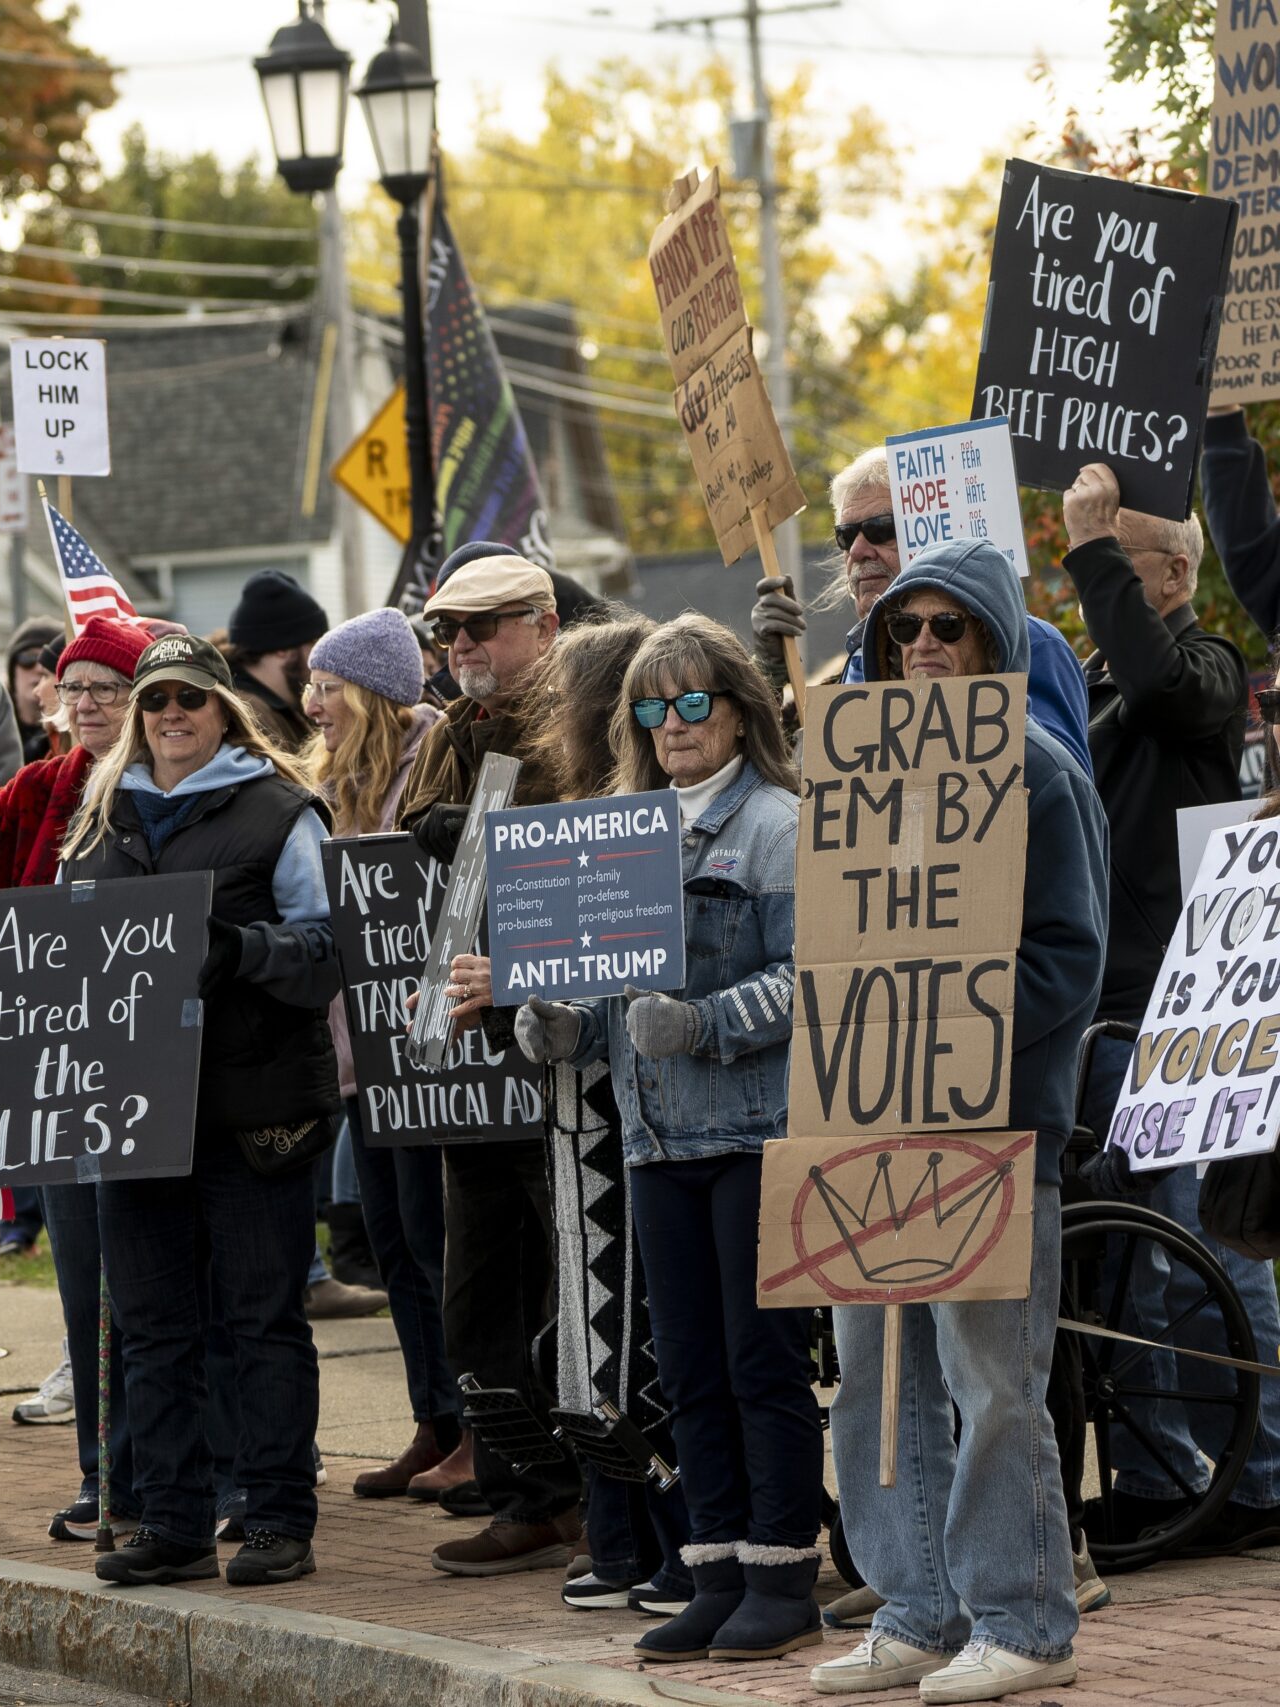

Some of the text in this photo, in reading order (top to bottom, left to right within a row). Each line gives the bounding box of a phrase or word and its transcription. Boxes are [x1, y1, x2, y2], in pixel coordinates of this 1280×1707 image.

[1213, 103, 1280, 157] UNIO
[1212, 148, 1280, 192] DEM
[1016, 174, 1158, 265] Are you
[650, 223, 698, 314] HANDS
[690, 199, 722, 268] OFF
[671, 262, 738, 357] OUR RIGHTS
[1029, 252, 1175, 336] tired of
[25, 350, 89, 371] LOCK
[1029, 326, 1120, 388] HIGH
[1242, 325, 1280, 346] HEA
[38, 384, 79, 404] HIM
[45, 418, 76, 438] UP
[981, 384, 1188, 472] BEEF PRICES?
[896, 440, 973, 481] FAITH not
[961, 449, 982, 470] FEAR
[900, 475, 977, 515] HOPE not
[965, 483, 987, 505] HATE
[904, 509, 982, 548] LOVE not
[970, 518, 988, 537] LIES
[822, 680, 1011, 774] GRAB
[494, 806, 669, 852] PRO-AMERICA
[804, 763, 1023, 852] 'EM BY
[340, 850, 451, 916] Are yo
[496, 868, 621, 896] pro-Constitution pro-family
[497, 889, 630, 916] pro-liberty pro-defense
[842, 863, 961, 934] THE
[100, 912, 176, 974] you
[361, 897, 432, 968] tired
[497, 902, 673, 935] pro-business pro-religious freedom
[1186, 883, 1280, 957] VOT
[507, 947, 667, 990] ANTI-TRUMP
[1201, 955, 1280, 1014] YOU
[108, 971, 154, 1042] of
[799, 958, 1011, 1126] VOTES
[34, 1043, 106, 1101] the
[366, 1082, 494, 1133] POLITICAL
[1109, 1075, 1280, 1160] USE IT!
